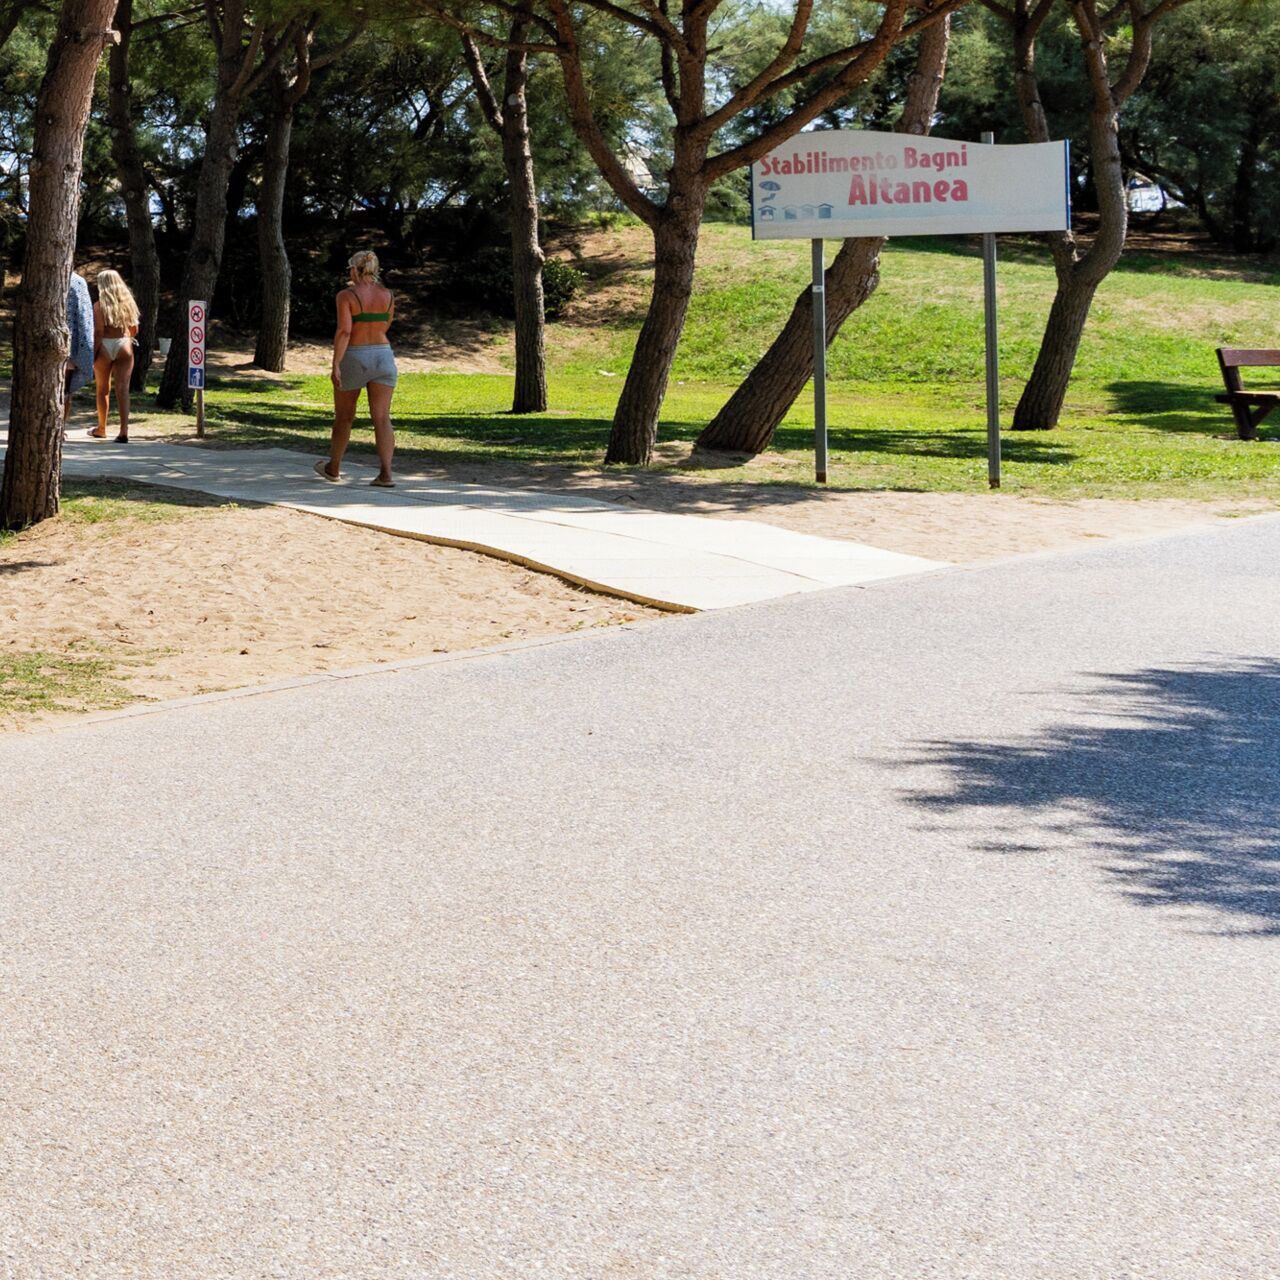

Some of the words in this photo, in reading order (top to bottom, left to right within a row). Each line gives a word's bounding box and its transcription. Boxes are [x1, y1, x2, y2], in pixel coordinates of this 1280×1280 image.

[760, 151, 898, 176] Stabilimento
[903, 144, 968, 172] Bagni
[847, 173, 969, 206] Altanea
